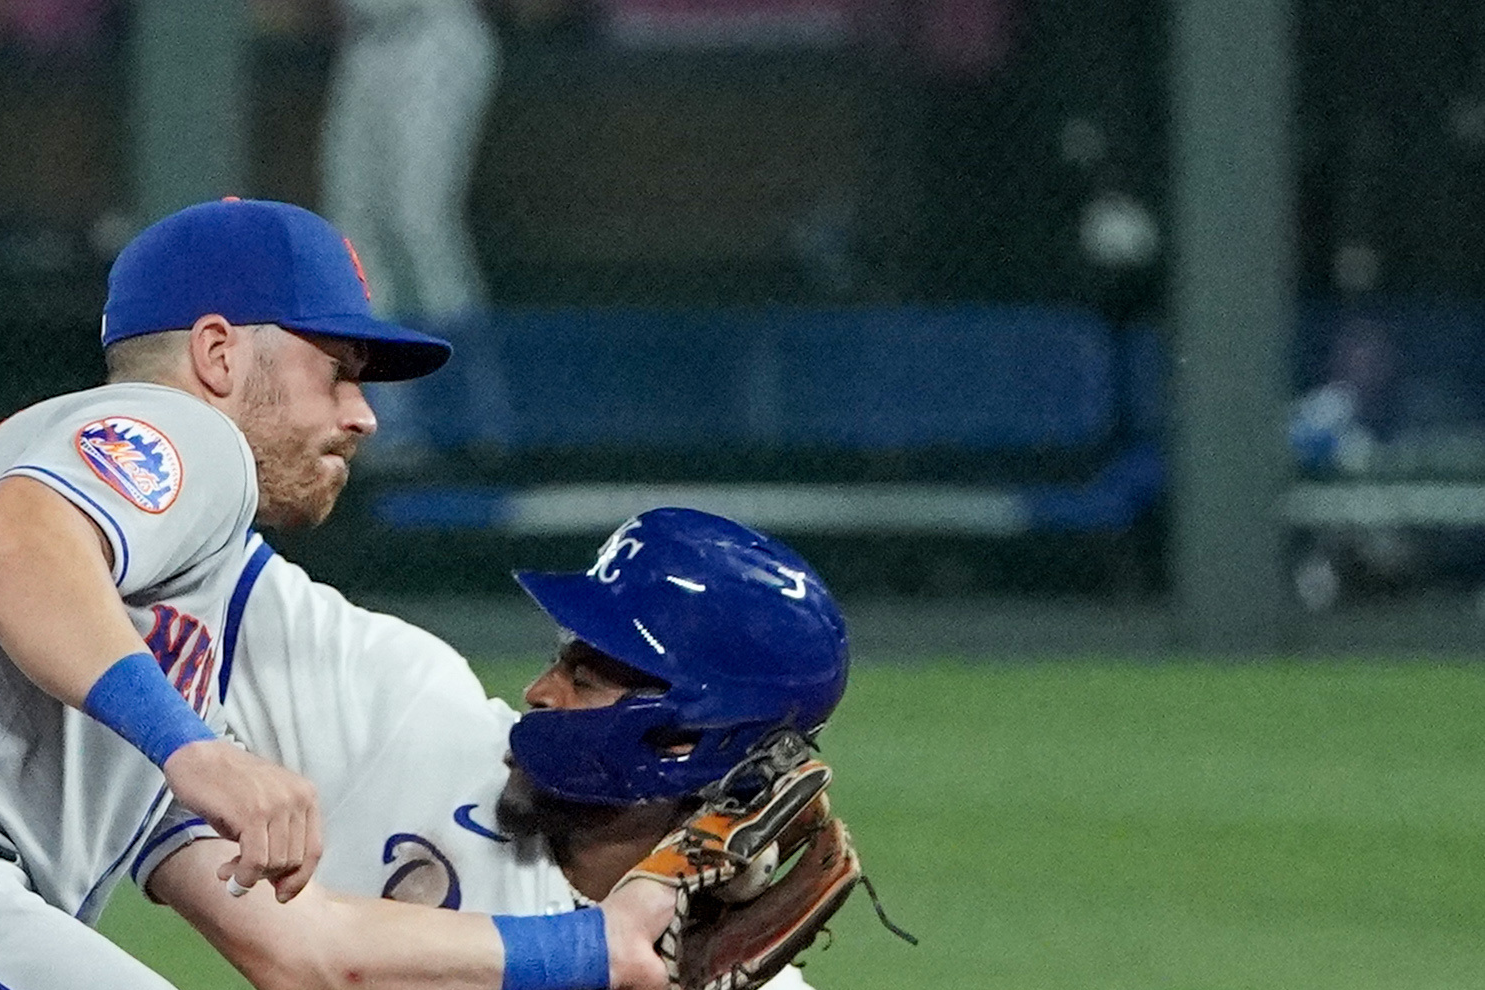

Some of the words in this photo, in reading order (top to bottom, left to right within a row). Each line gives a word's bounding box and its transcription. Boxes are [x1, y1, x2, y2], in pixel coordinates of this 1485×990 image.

[89, 437, 161, 496] Mets
[586, 516, 645, 583] KC
[143, 603, 214, 722] NE
